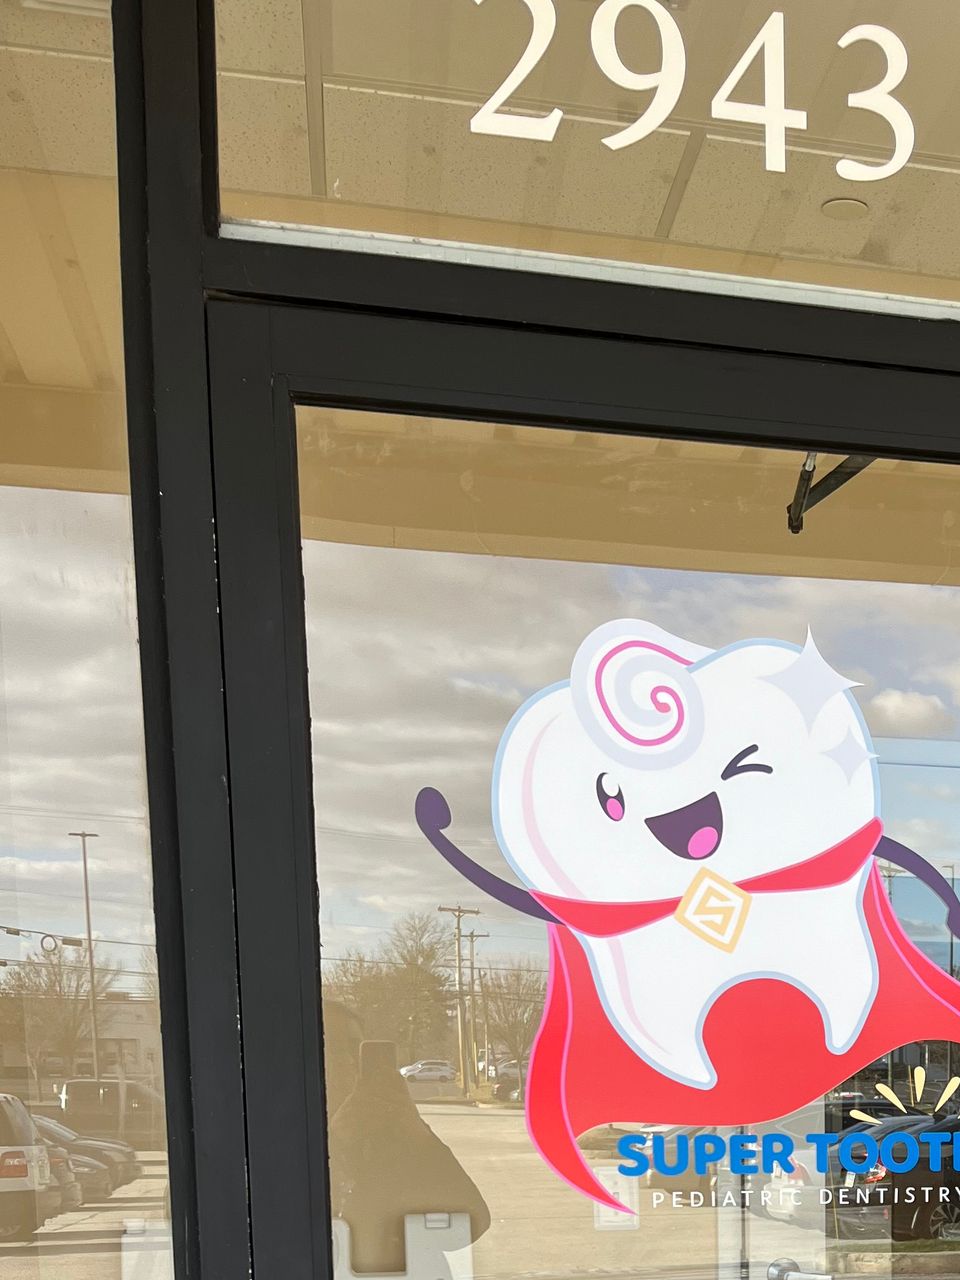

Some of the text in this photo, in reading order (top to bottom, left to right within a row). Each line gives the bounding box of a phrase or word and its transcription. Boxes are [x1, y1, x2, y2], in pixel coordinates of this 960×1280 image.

[470, 0, 915, 181] 2943
[616, 1132, 796, 1177] SUPER
[652, 1190, 802, 1209] PEDIATRIC
